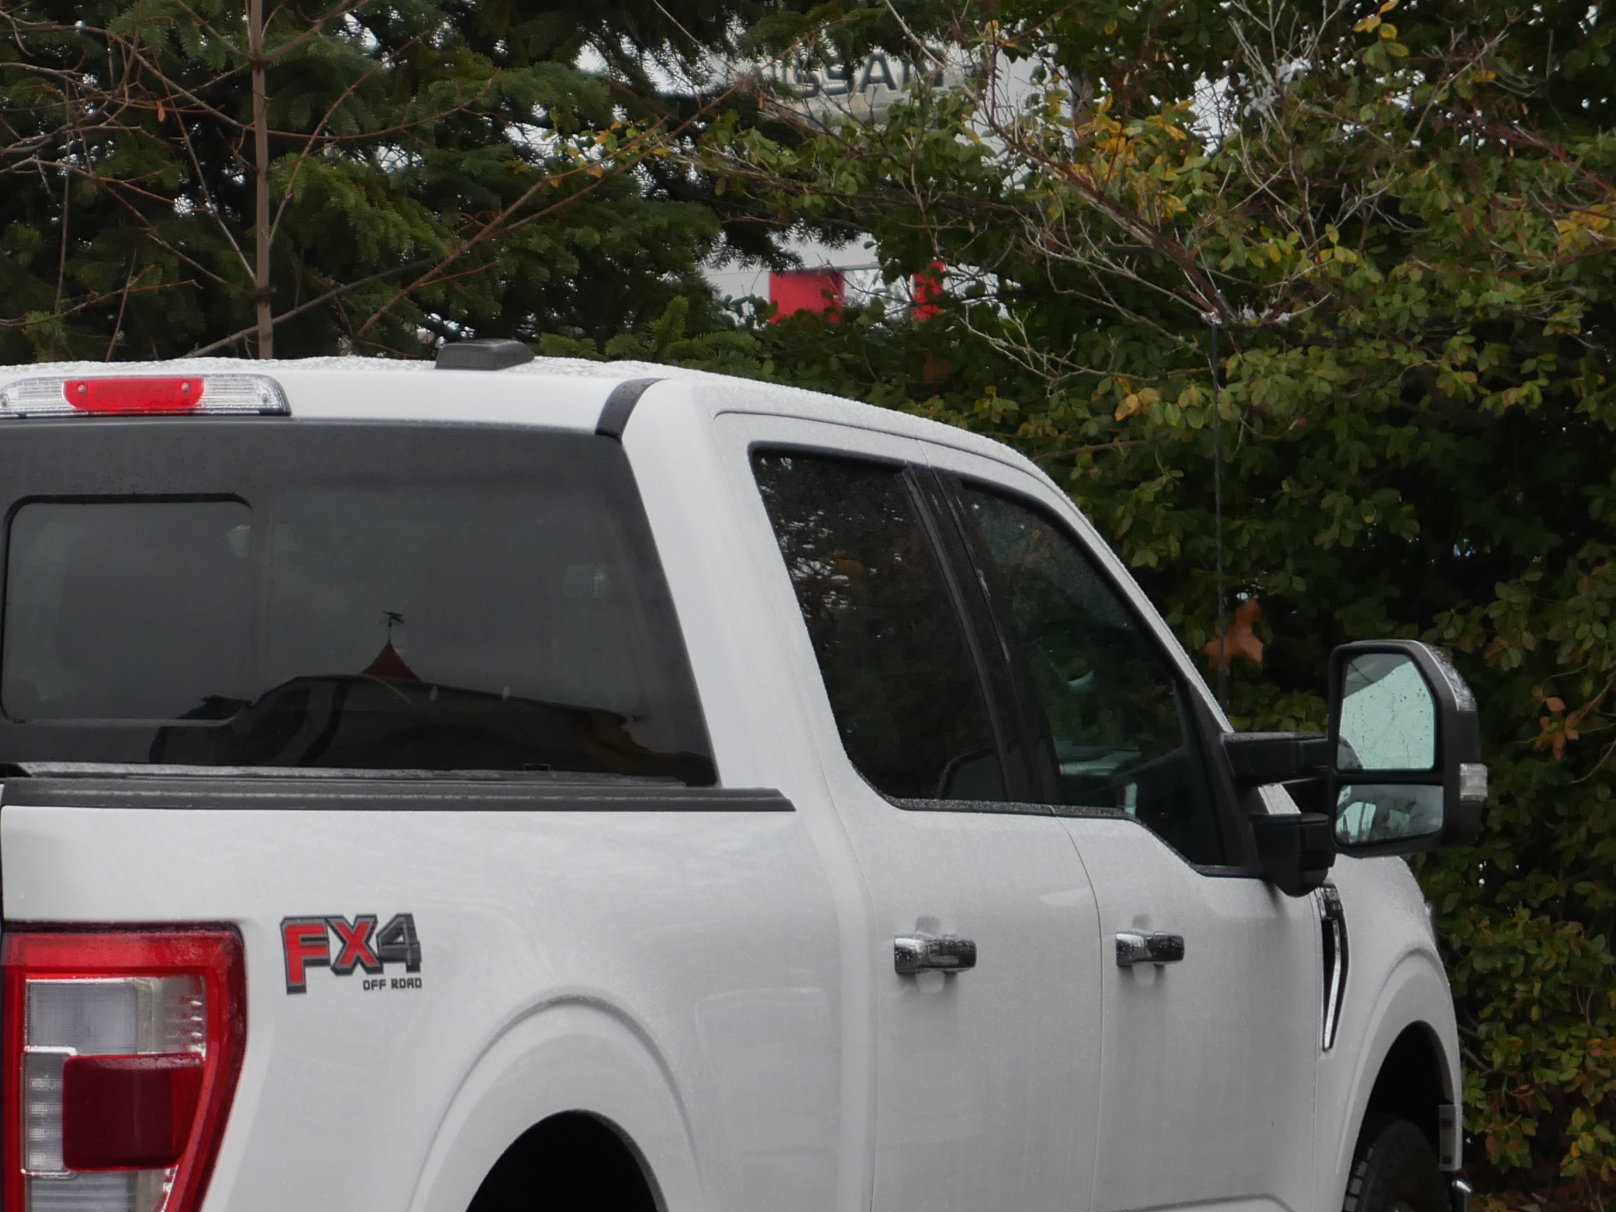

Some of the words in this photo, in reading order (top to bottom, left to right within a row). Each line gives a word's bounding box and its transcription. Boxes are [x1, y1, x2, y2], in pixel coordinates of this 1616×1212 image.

[280, 912, 422, 995] FX4
[363, 979, 387, 991] OFF
[391, 977, 422, 990] ROAD
